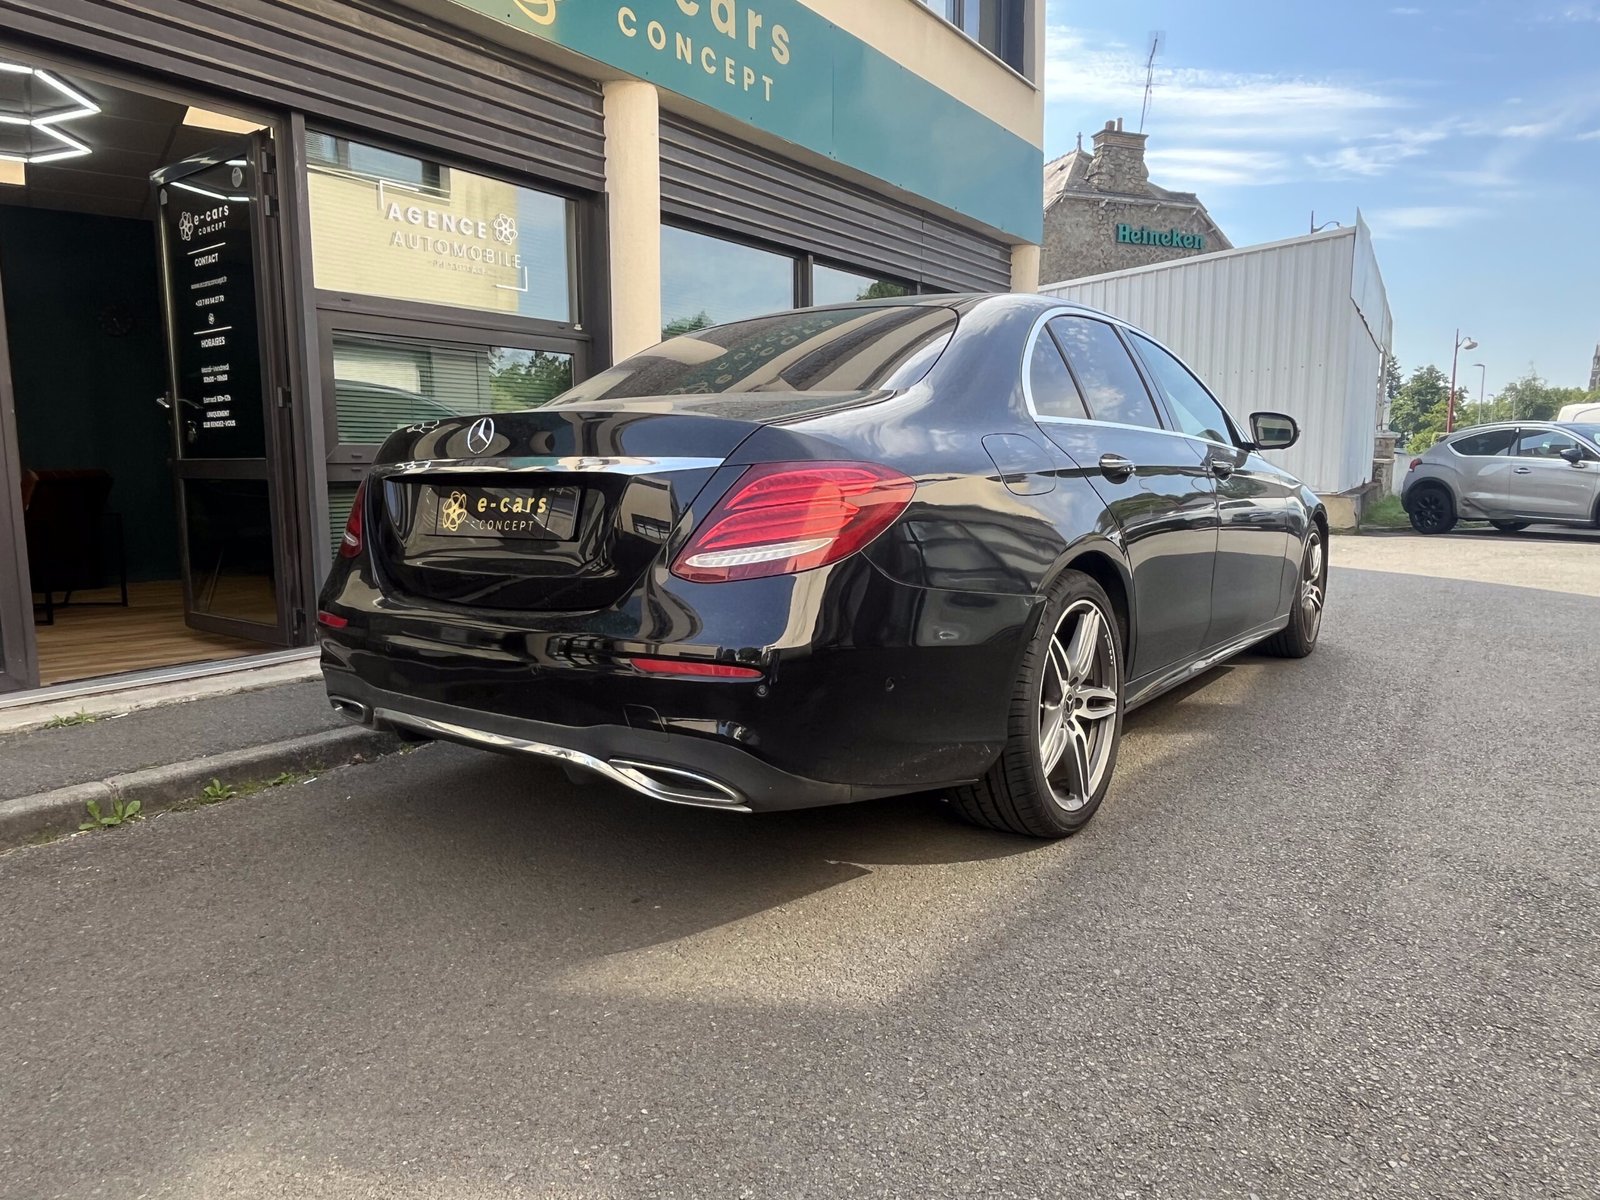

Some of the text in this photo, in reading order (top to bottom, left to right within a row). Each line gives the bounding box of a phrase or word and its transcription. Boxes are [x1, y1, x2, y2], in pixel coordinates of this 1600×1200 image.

[617, 6, 774, 102] CONCEPT
[193, 205, 229, 226] e-cars
[386, 202, 487, 239] AGENCE
[198, 221, 226, 236] CONCEPT
[1117, 223, 1205, 249] Heineken
[194, 253, 218, 267] CONTACT
[391, 231, 521, 269] AUTOMOBILE
[477, 496, 547, 514] e-cars
[479, 519, 534, 532] CONCEPT
